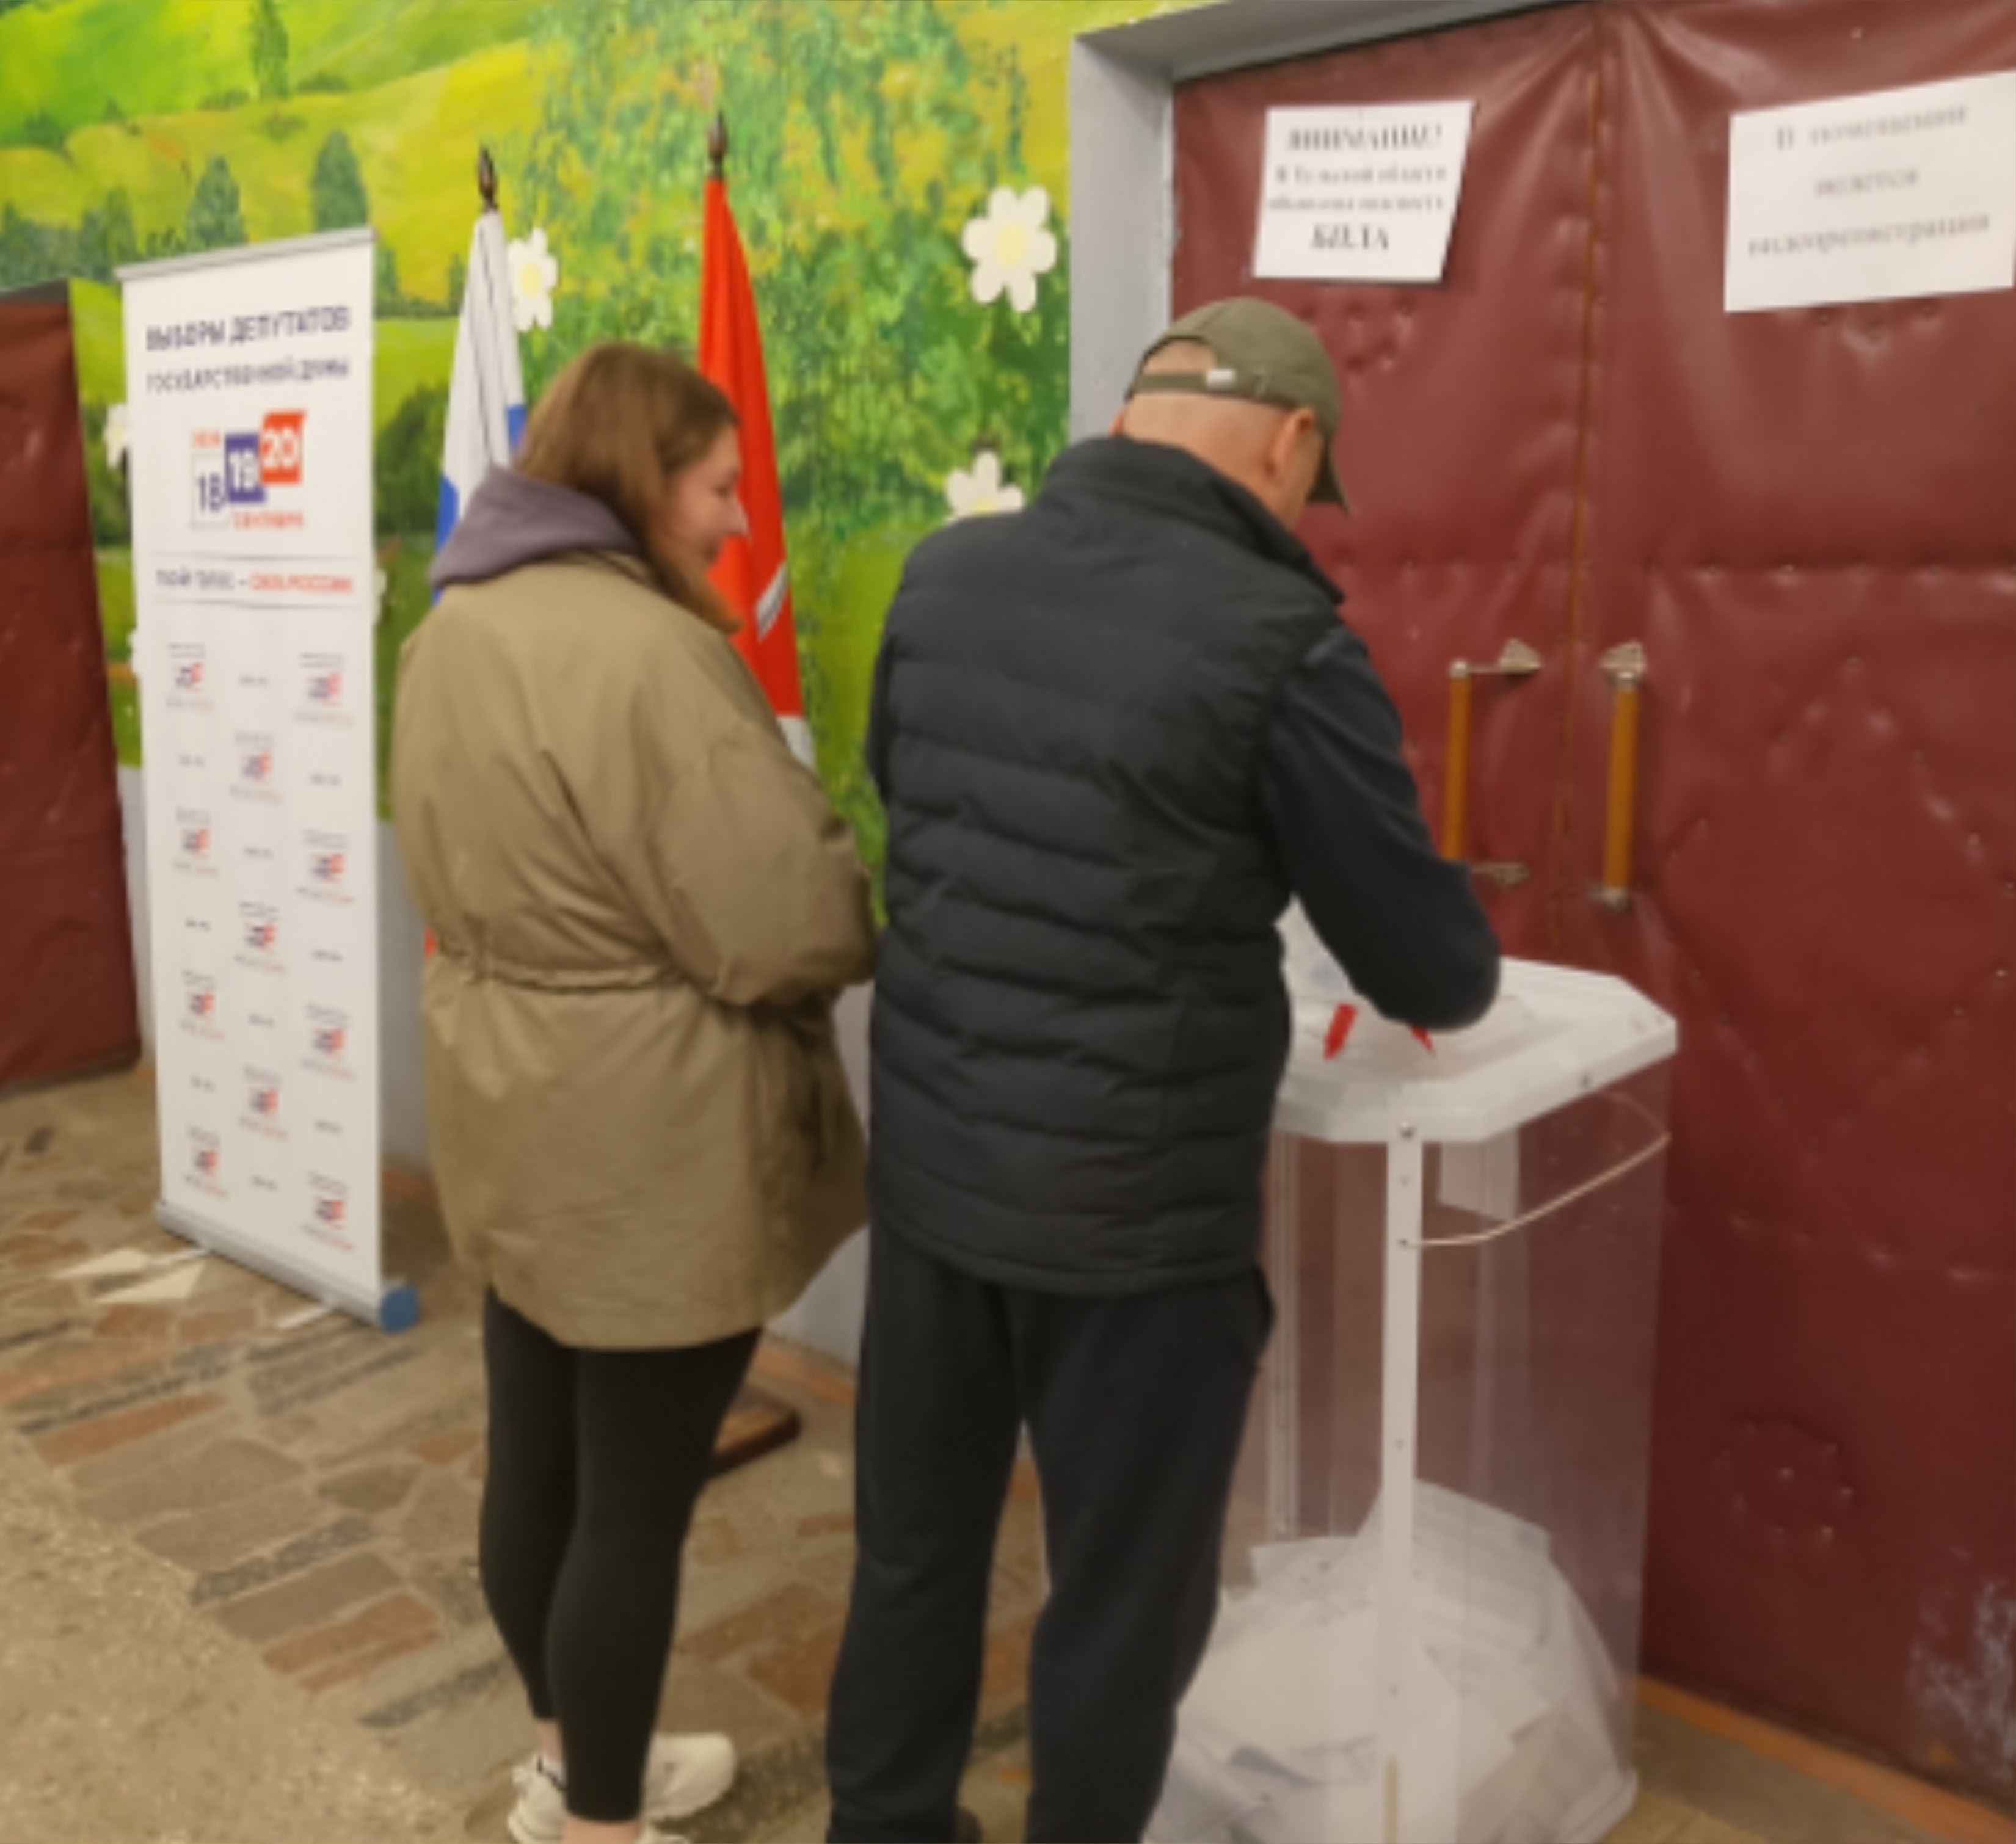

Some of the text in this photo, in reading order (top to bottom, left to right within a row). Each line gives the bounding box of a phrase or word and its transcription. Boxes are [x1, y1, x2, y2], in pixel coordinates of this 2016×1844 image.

[146, 306, 349, 352] ВЫБОРЫ ДЕПУТАТОВ
[198, 428, 297, 512] 18 19 20
